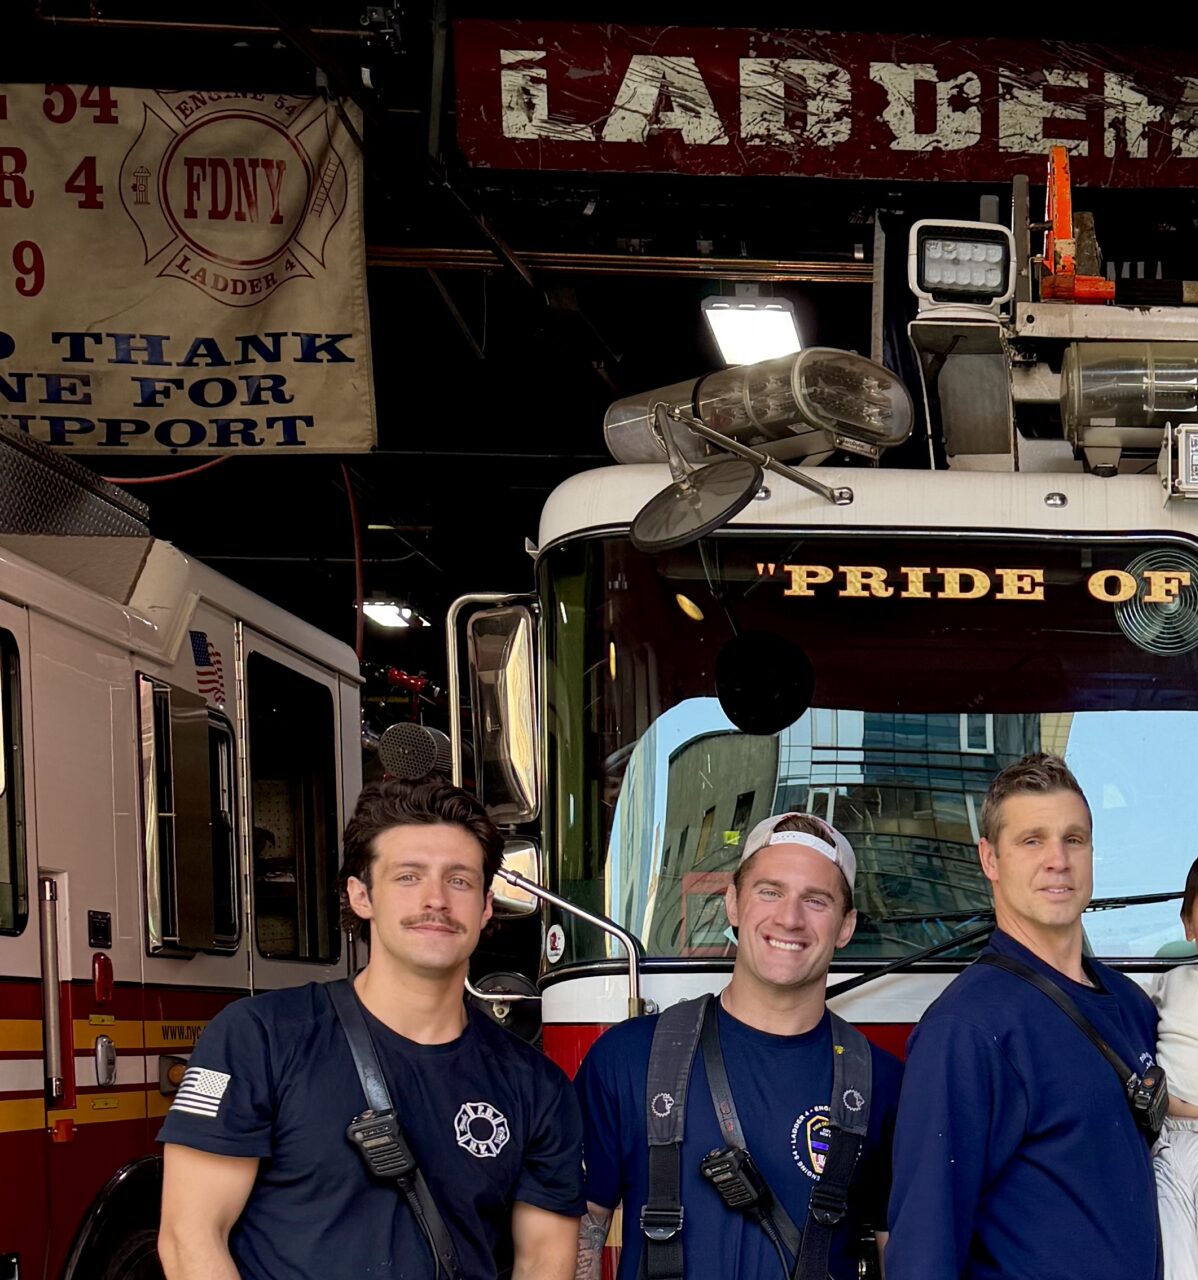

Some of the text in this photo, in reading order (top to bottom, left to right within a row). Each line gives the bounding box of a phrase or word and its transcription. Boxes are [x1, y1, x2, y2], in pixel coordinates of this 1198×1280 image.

[42, 83, 119, 124] 54
[274, 95, 298, 116] 54
[65, 156, 104, 209] 4
[183, 157, 287, 224] FDNY
[12, 240, 45, 297] 9
[176, 254, 297, 296] LADDER 4
[52, 330, 355, 367] THANK
[131, 374, 295, 407] FOR
[1087, 569, 1192, 603] OF
[790, 1114, 806, 1144] LADDER
